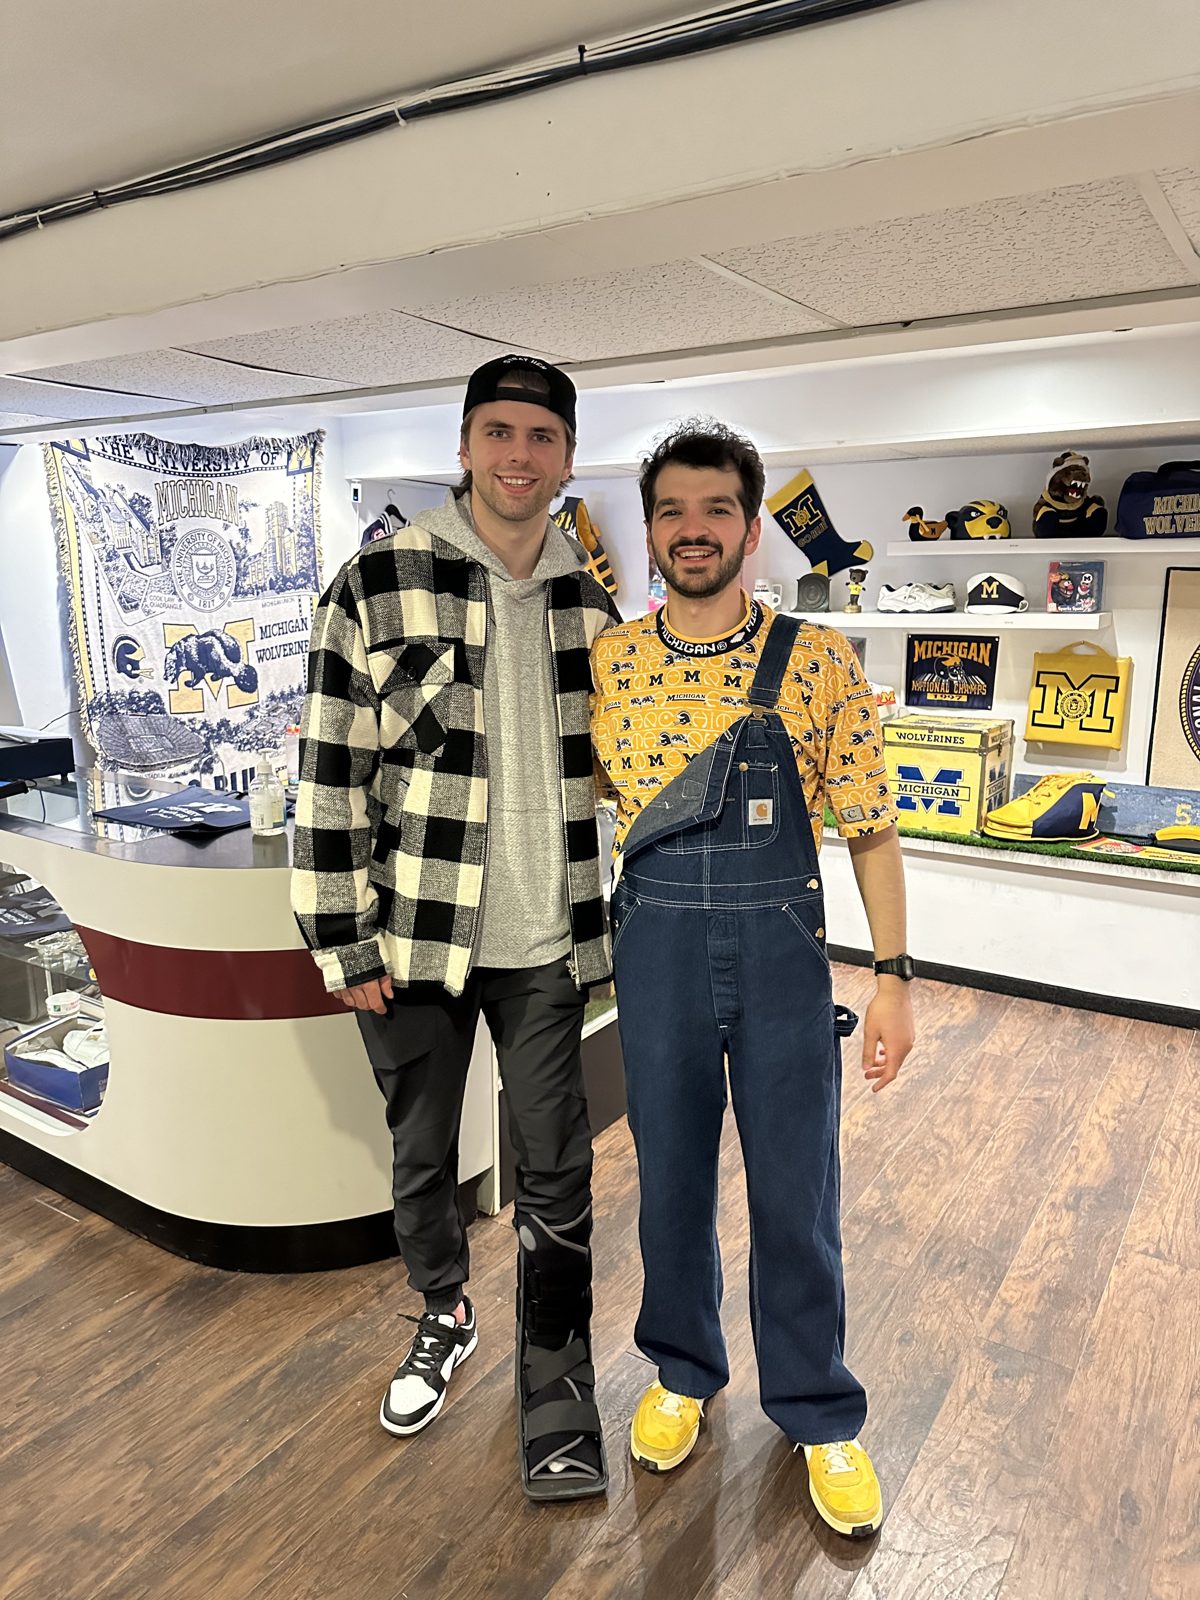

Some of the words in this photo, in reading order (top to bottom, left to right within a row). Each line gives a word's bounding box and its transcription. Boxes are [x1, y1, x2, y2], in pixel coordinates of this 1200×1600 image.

[260, 451, 279, 466] OF
[155, 479, 239, 527] MICHIGAN
[207, 534, 218, 545] OF
[175, 533, 206, 568] UNIVERSITY
[217, 543, 234, 588] MICHIGAN
[176, 570, 187, 590] THE
[981, 582, 999, 599] M
[198, 600, 215, 608] 1817
[259, 617, 309, 640] MICHIGAN
[913, 640, 992, 667] MICHIGAN
[649, 673, 664, 687] M
[684, 670, 701, 683] M
[723, 674, 742, 688] M
[617, 678, 631, 690] M
[912, 680, 950, 693] NATIONAL
[953, 683, 987, 696] CHAMPS
[666, 694, 706, 702] MICHIGAN
[880, 691, 896, 703] M
[1031, 670, 1120, 734] M
[896, 732, 965, 744] WOLVERINES
[621, 756, 632, 769] M
[648, 753, 664, 767] M
[840, 752, 856, 766] M
[898, 784, 960, 797] MICHIGAN
[1174, 803, 1193, 826] 5
